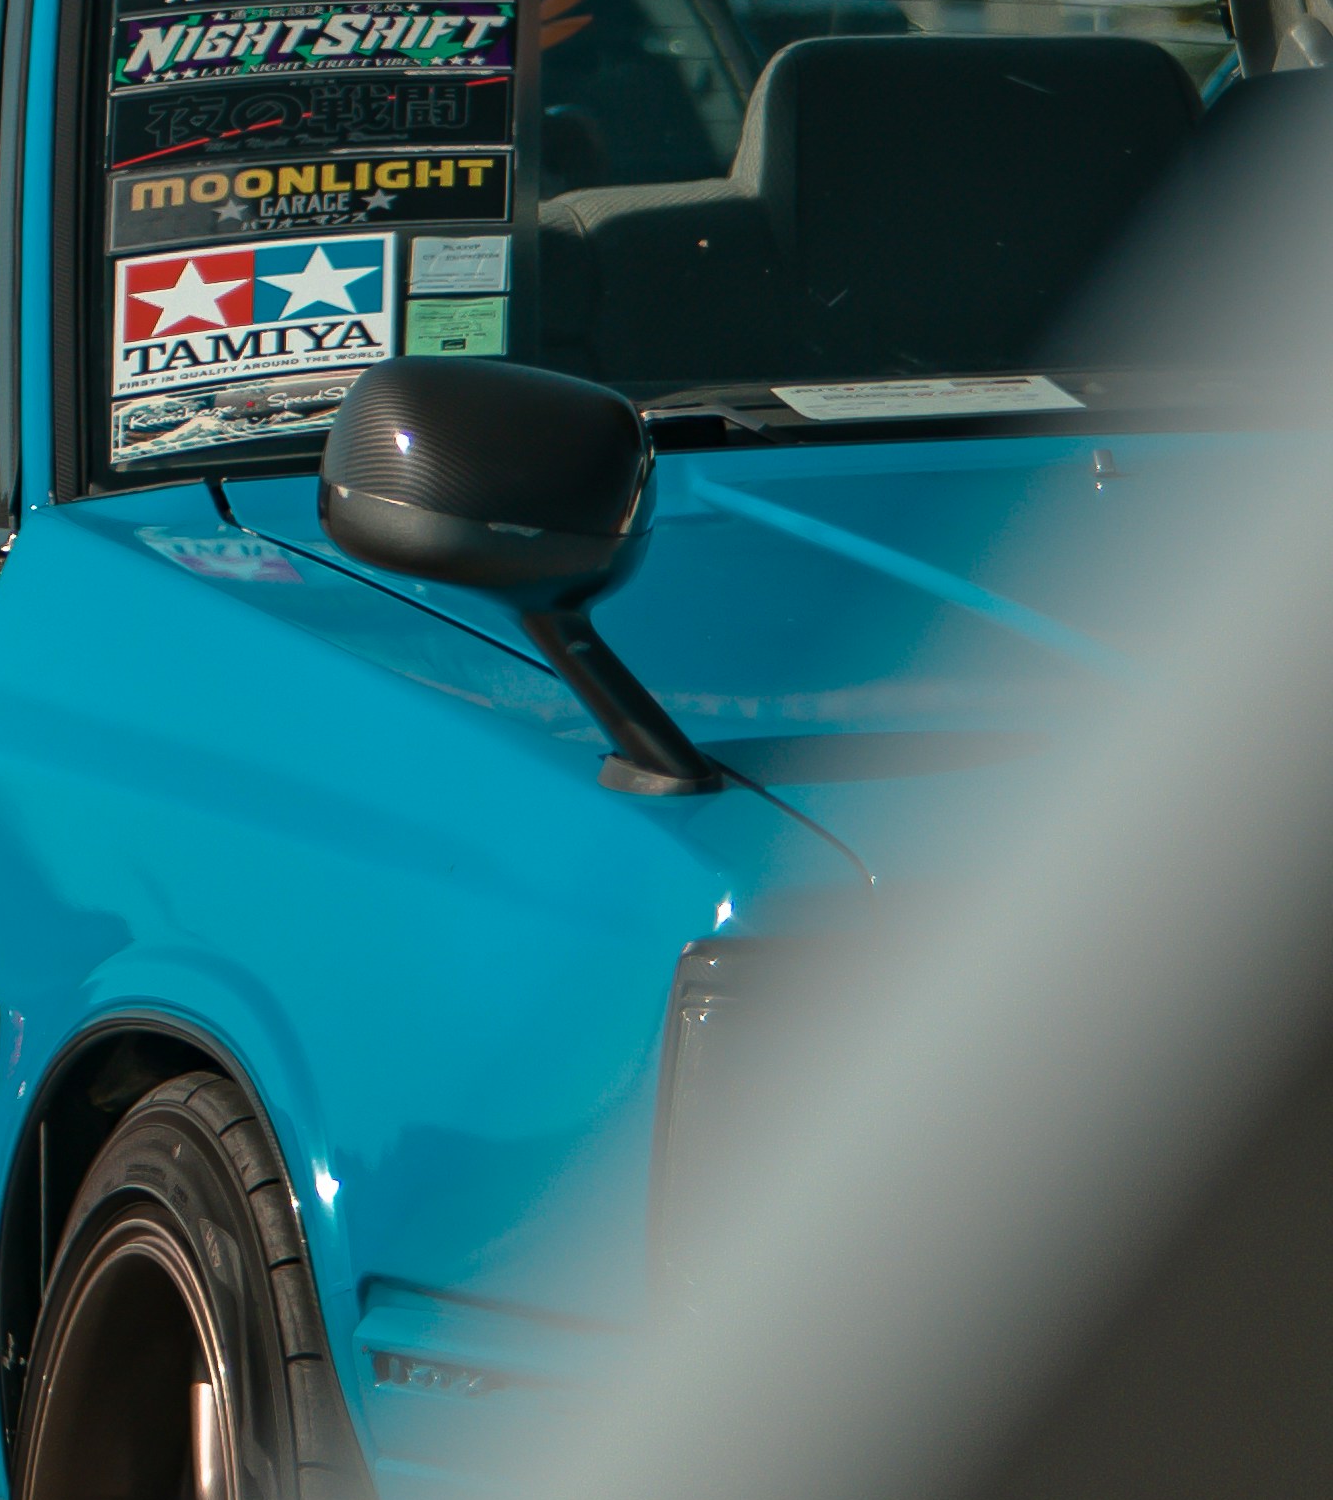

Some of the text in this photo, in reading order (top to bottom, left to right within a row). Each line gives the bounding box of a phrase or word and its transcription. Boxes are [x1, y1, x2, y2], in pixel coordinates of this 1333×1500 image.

[199, 57, 422, 78] LATE NIGHT STREET VIBES
[129, 158, 494, 212] MOONLIGHT
[259, 191, 351, 218] GARAGE
[118, 349, 386, 391] FIRST IN QUALITY AROUND THE WORLD
[123, 320, 383, 378] TAMIYA
